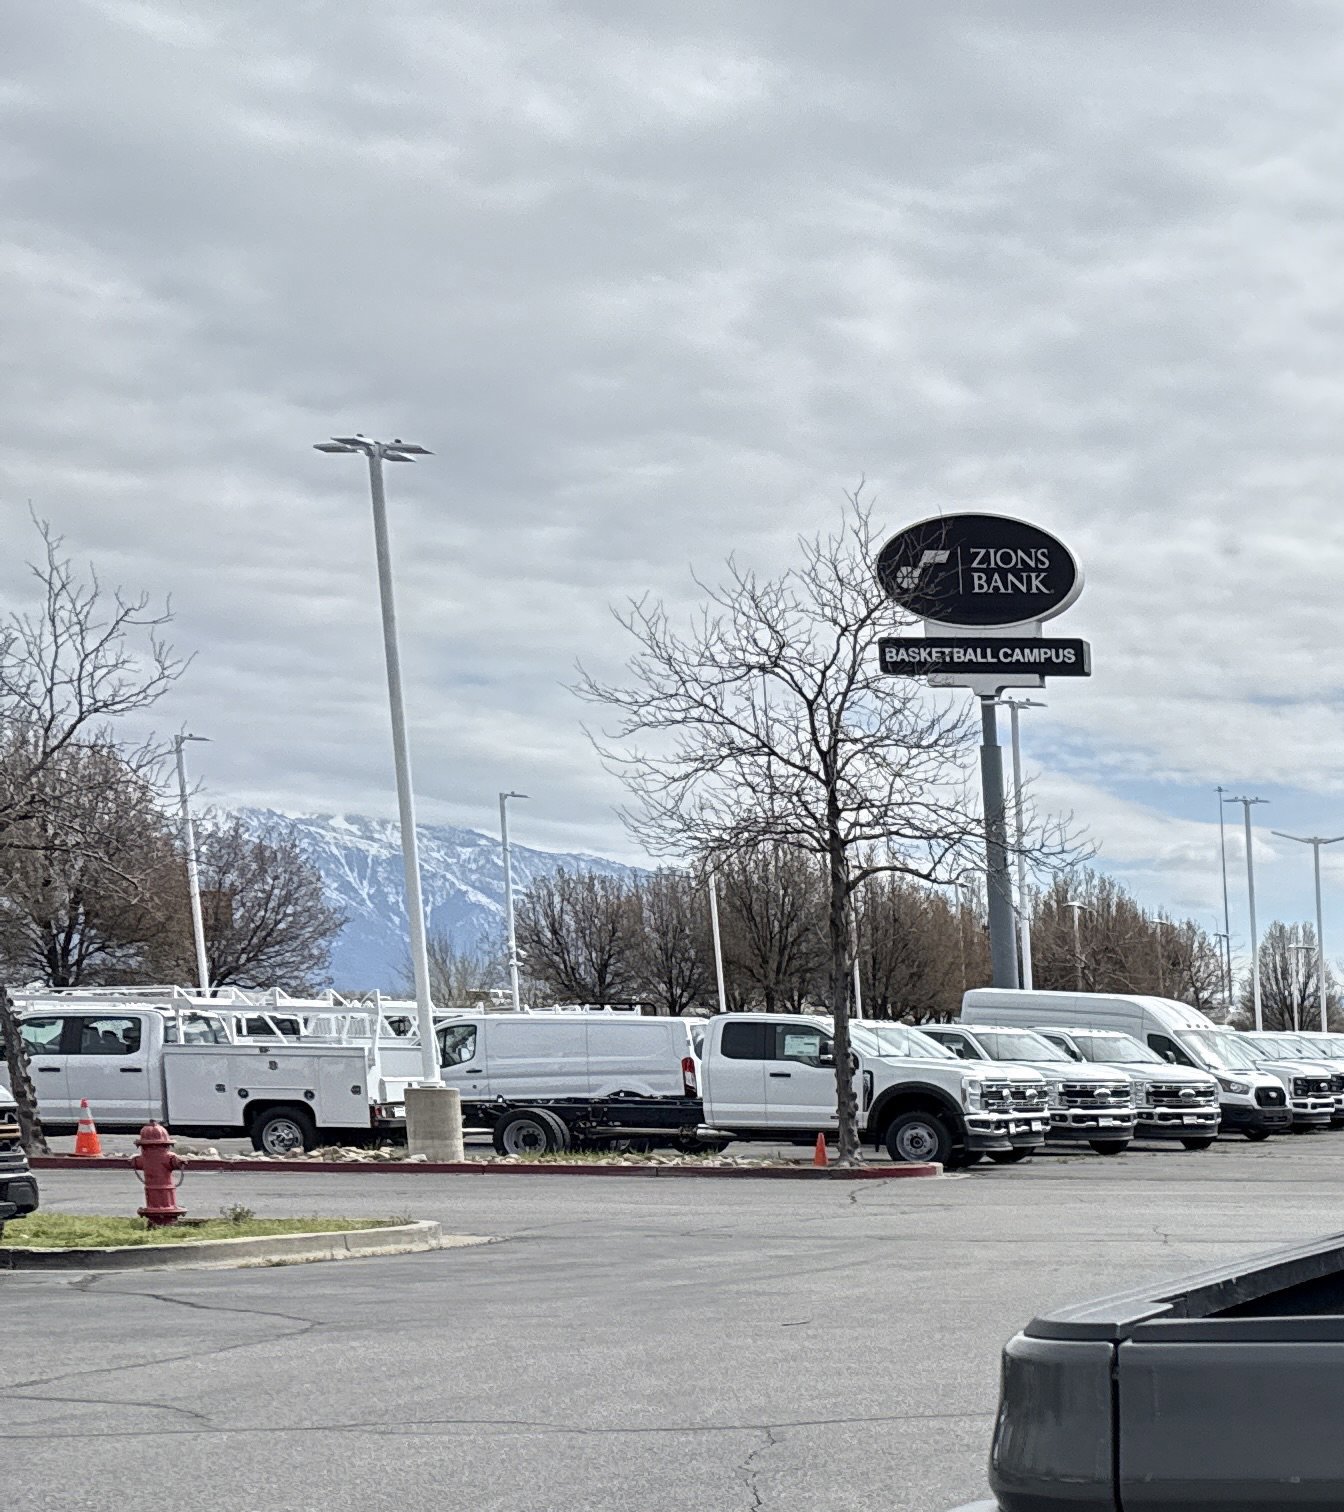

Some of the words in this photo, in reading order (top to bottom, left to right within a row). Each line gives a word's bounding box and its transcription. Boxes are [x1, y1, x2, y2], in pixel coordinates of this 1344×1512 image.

[970, 548, 1050, 569] ZIONS
[971, 572, 1051, 594] BANK
[885, 647, 998, 663] BASKETBALL
[999, 647, 1076, 664] CAMPUS
